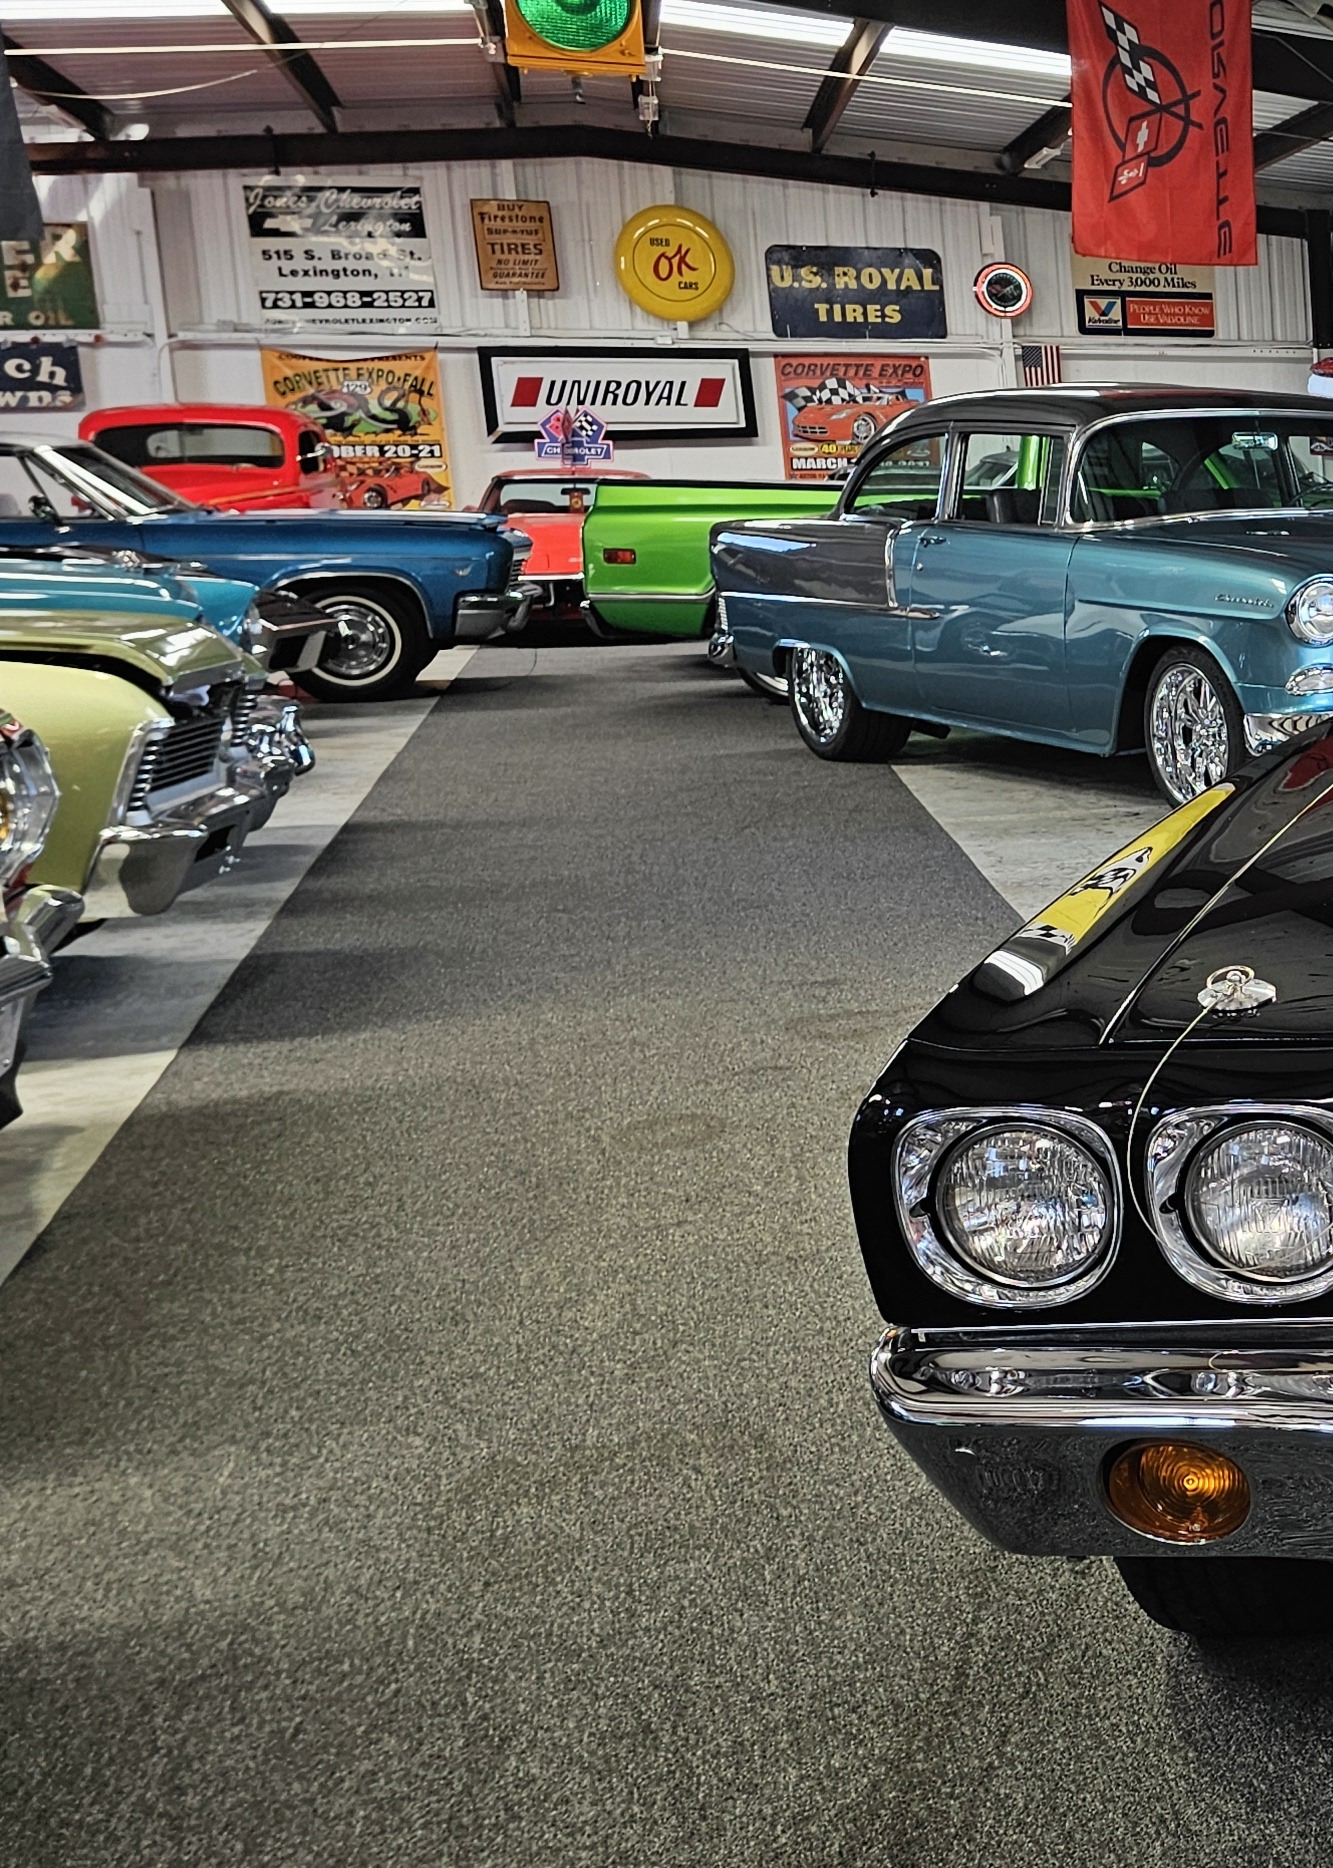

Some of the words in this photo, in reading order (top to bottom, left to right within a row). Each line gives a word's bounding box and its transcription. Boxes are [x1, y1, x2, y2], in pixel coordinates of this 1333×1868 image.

[249, 188, 308, 215] Jones
[319, 187, 421, 213] Chevrolet
[497, 203, 524, 211] BUY
[478, 212, 544, 223] Firestone
[321, 215, 412, 235] Lexington
[487, 242, 543, 255] TIRES
[649, 238, 670, 248] USED
[262, 249, 294, 261] 515
[304, 249, 322, 261] S.
[331, 249, 389, 261] Broad
[496, 258, 510, 266] NO
[513, 258, 539, 266] LIMIT
[653, 244, 698, 281] OK
[1108, 261, 1156, 275] Change
[1158, 262, 1178, 275] Oil
[278, 266, 378, 280] Lexington,
[493, 271, 546, 279] GUARANTEE
[770, 265, 828, 289] U.S.
[836, 267, 940, 291] ROYAL
[678, 281, 699, 291] CARS
[1090, 275, 1124, 289] Every
[1127, 276, 1161, 289] 3,000
[1163, 276, 1197, 289] Miles
[262, 291, 432, 308] 731-968-2527
[814, 304, 902, 324] TIRES
[780, 362, 874, 378] CORVETTE
[878, 363, 924, 378] EXPO
[273, 367, 351, 397] CORVETTE
[545, 379, 689, 407] UNIROYAL
[384, 446, 441, 457] 20-21
[821, 443, 837, 453] 40
[792, 457, 848, 469] MARCH
